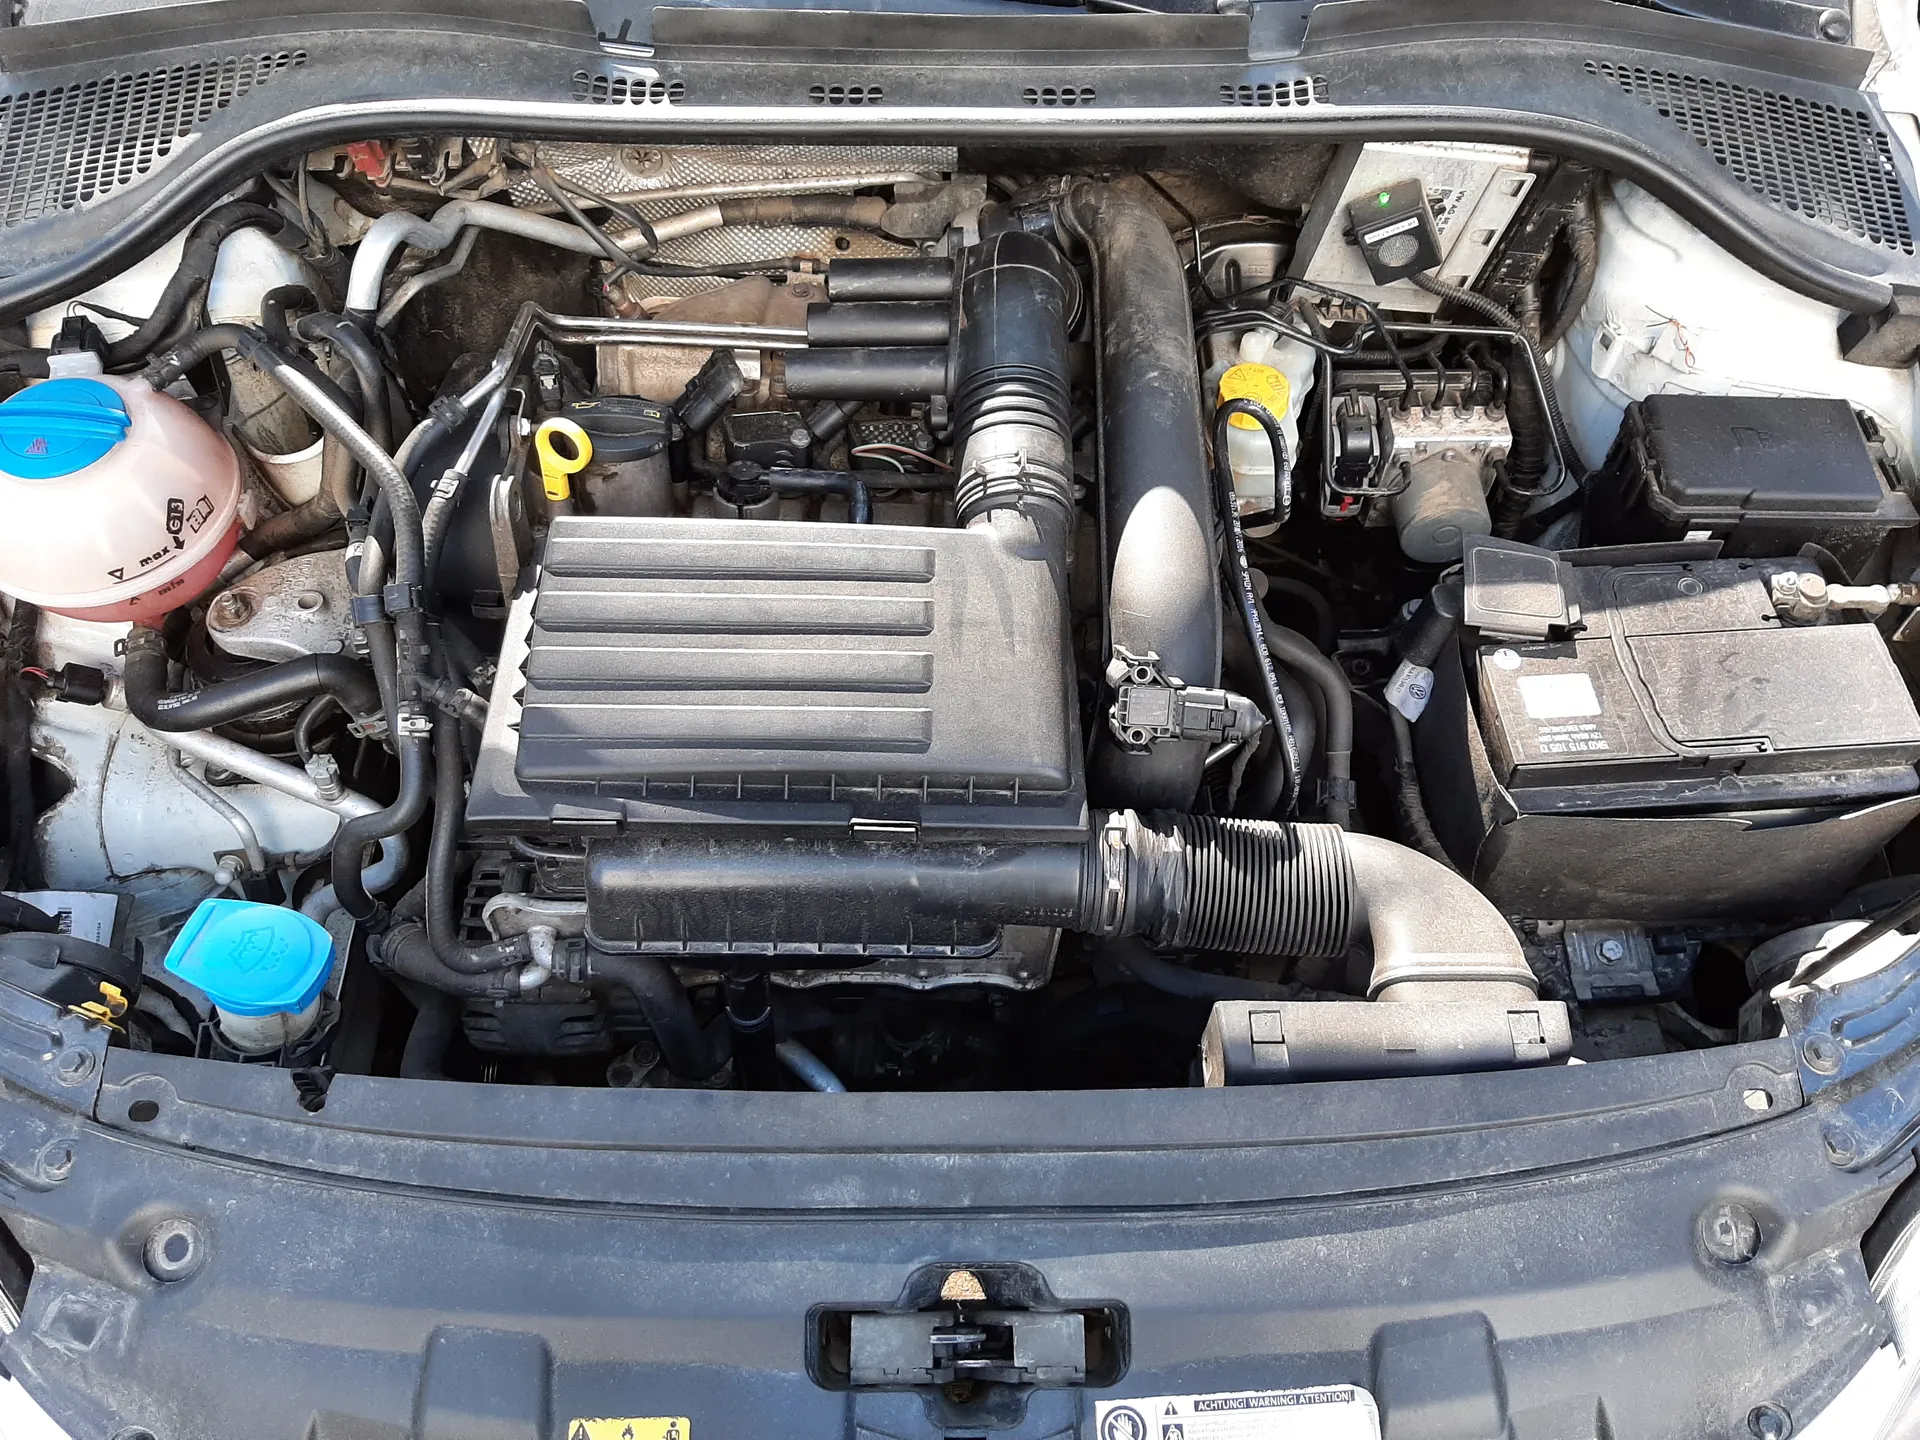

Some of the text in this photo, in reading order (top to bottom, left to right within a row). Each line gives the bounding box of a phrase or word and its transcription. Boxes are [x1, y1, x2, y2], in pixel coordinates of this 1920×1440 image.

[1447, 190, 1467, 215] VW AG
[169, 502, 182, 531] G13
[139, 546, 171, 568] max
[1264, 657, 1274, 670] 612
[1549, 742, 1569, 753] 105
[1568, 741, 1588, 752] 915
[1588, 740, 1610, 751] 5K0
[1198, 1398, 1246, 1411] ACHTUNG!
[1248, 1395, 1297, 1408] WARNING!
